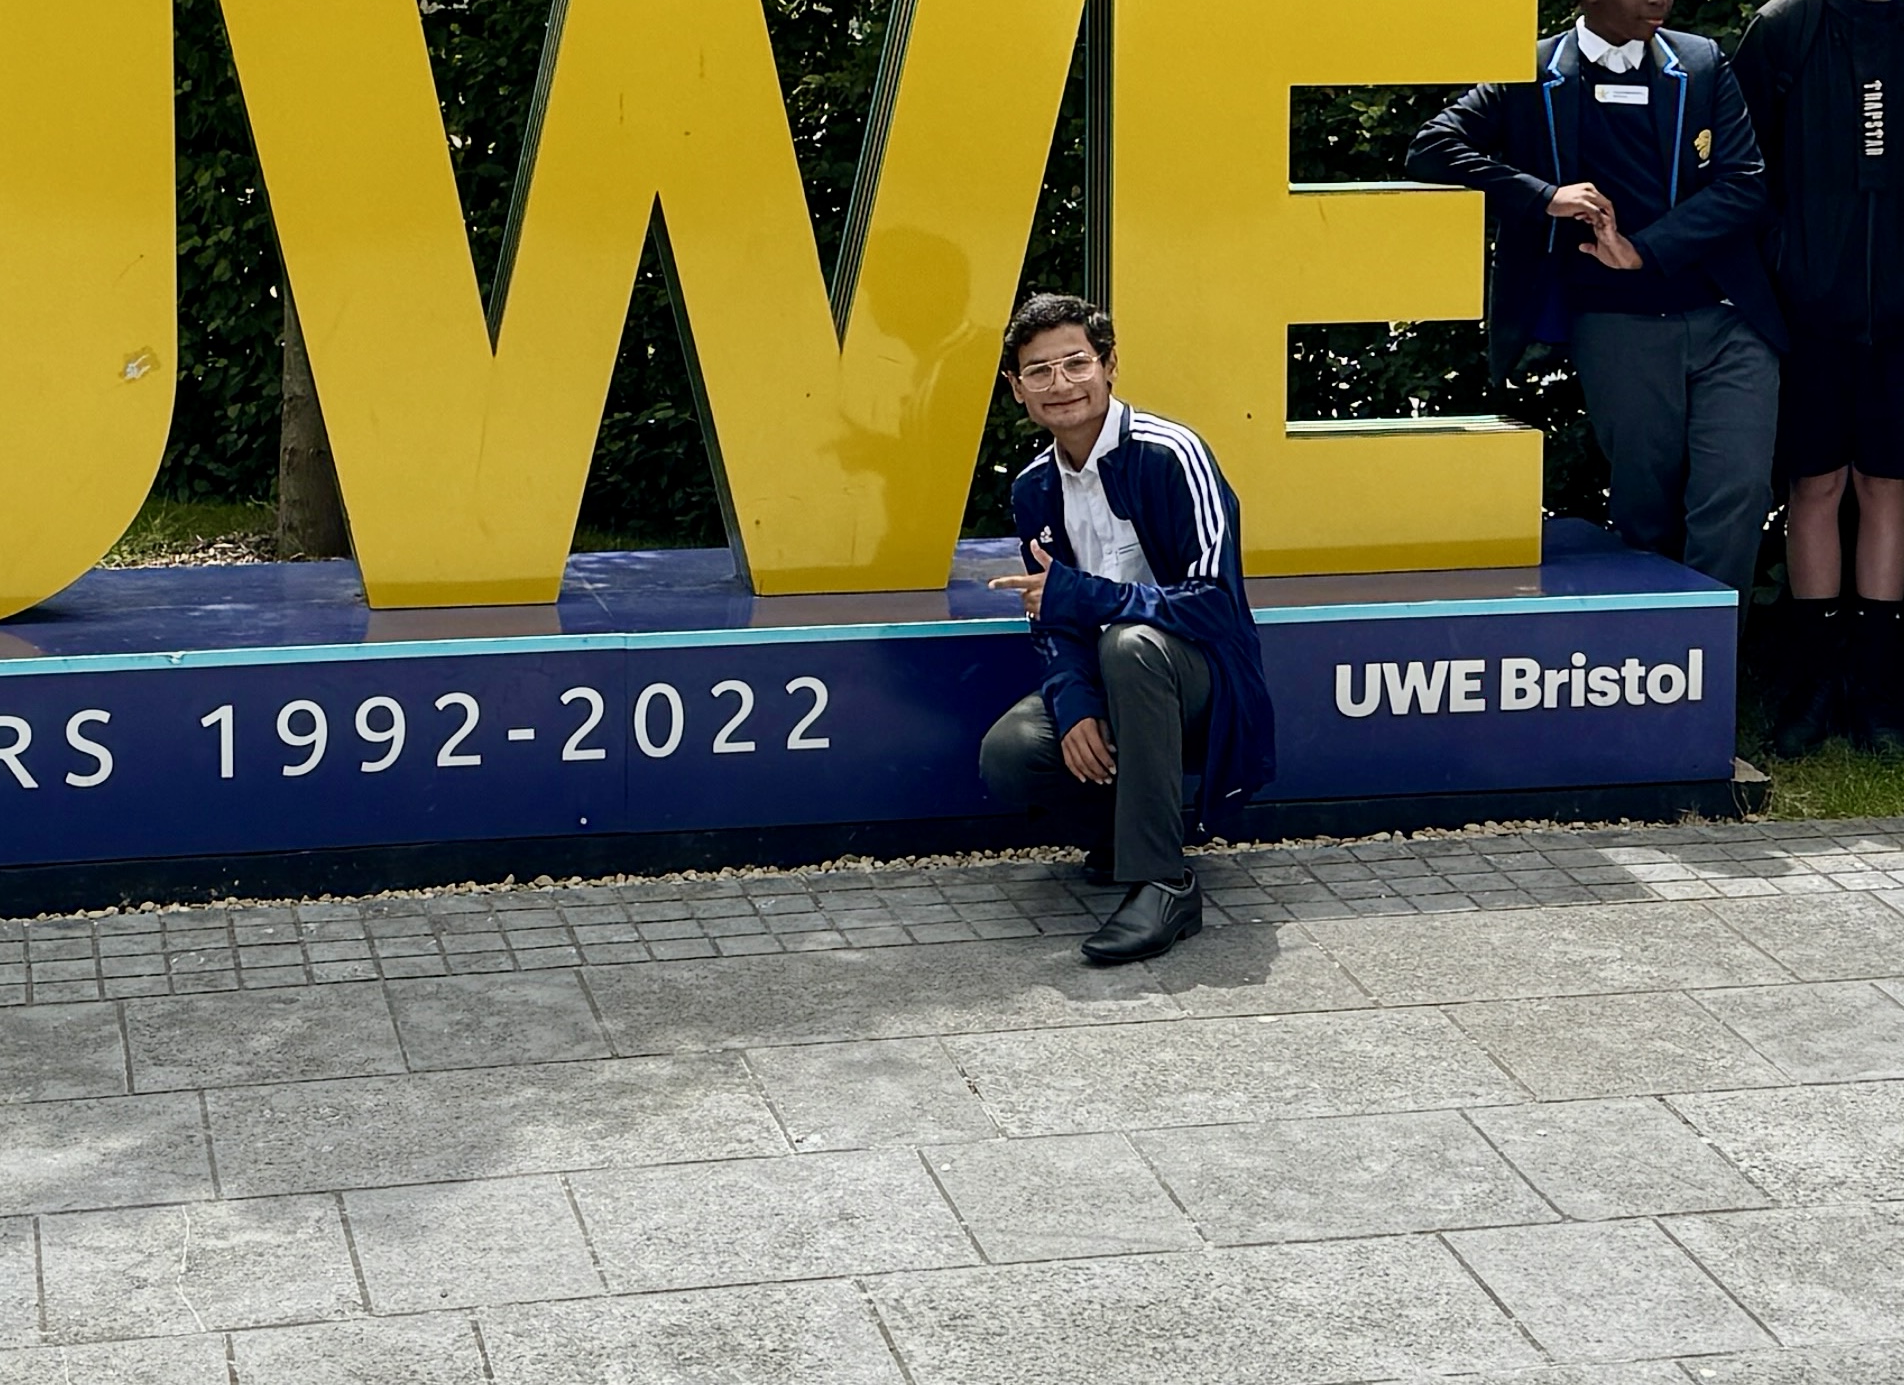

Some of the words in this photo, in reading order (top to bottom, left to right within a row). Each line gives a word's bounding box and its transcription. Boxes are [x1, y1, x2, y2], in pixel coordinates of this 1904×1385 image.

[1863, 79, 1884, 156] TRAPSTAR
[1335, 659, 1486, 718] UWE
[1500, 648, 1704, 711] Bristol
[200, 676, 831, 779] 1992-2022
